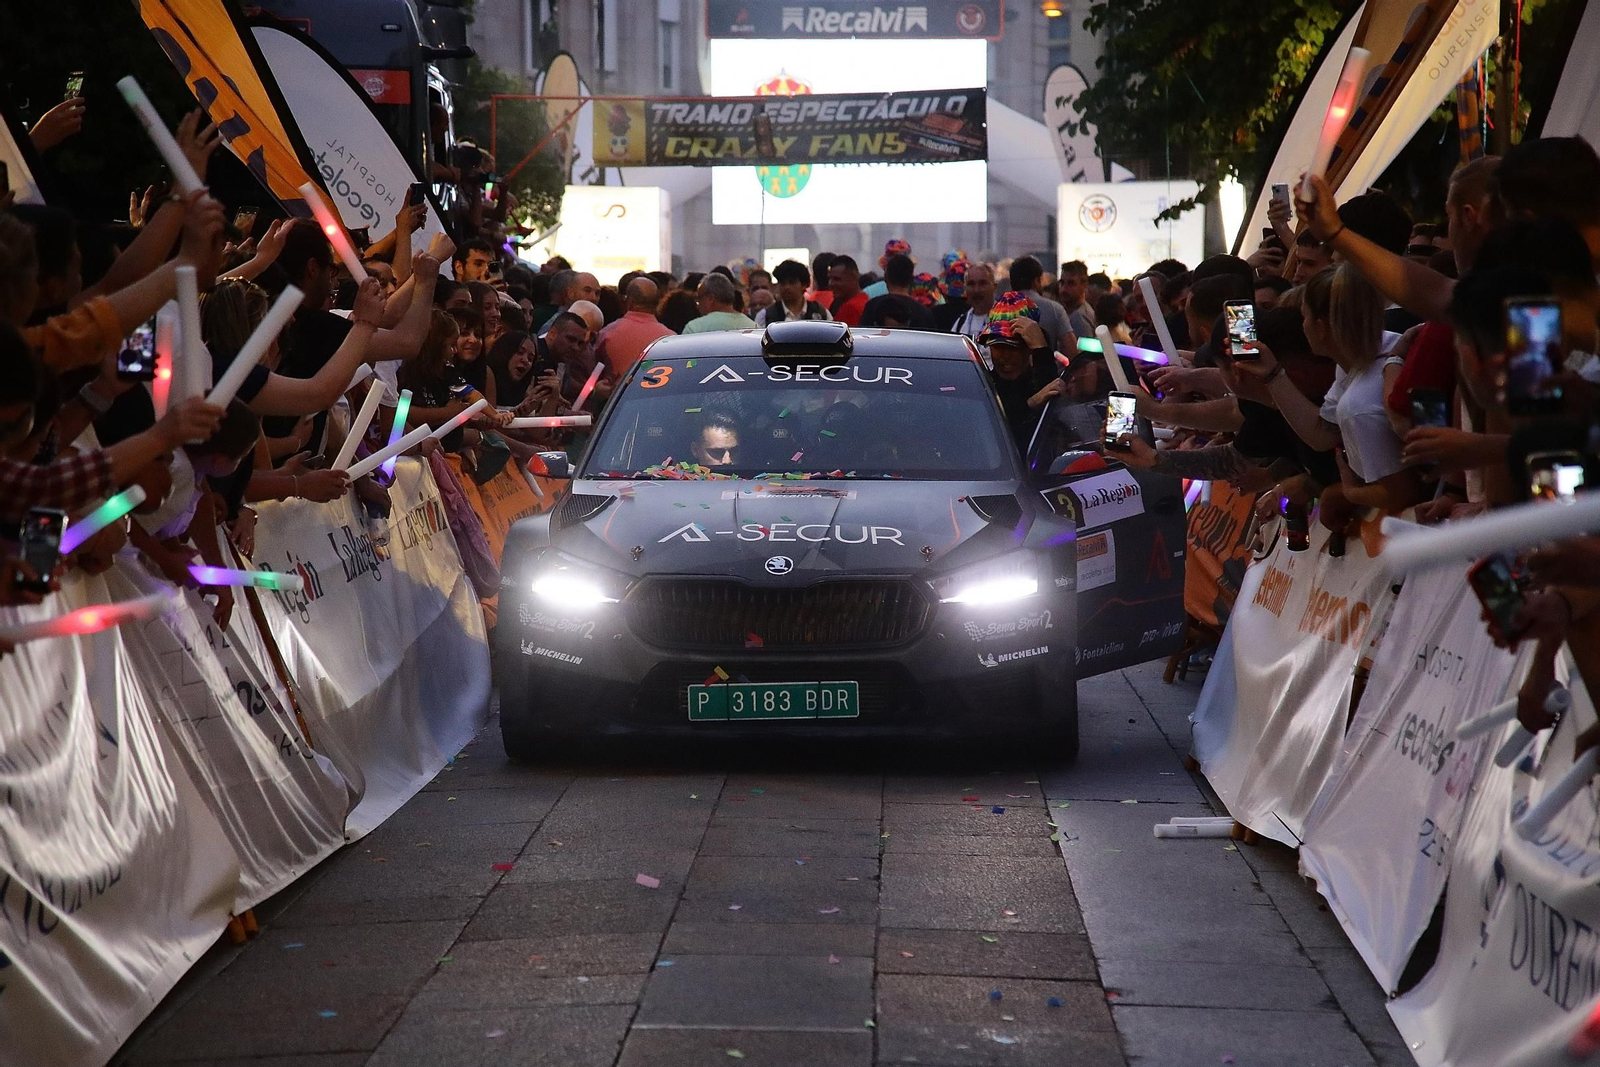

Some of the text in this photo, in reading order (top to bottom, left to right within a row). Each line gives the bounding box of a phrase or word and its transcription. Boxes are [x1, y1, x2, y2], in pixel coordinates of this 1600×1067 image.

[805, 7, 904, 33] Recalvi
[1428, 4, 1492, 80] OURENSE
[651, 92, 967, 126] TRAMO ESPECTÁCULO
[640, 366, 673, 388] 3
[699, 363, 913, 386] A-SECUR
[658, 522, 905, 547] A-SECUR
[534, 646, 583, 665] MICHELIN
[998, 645, 1049, 662] MICHELIN
[698, 688, 849, 713] P 3183 BDR
